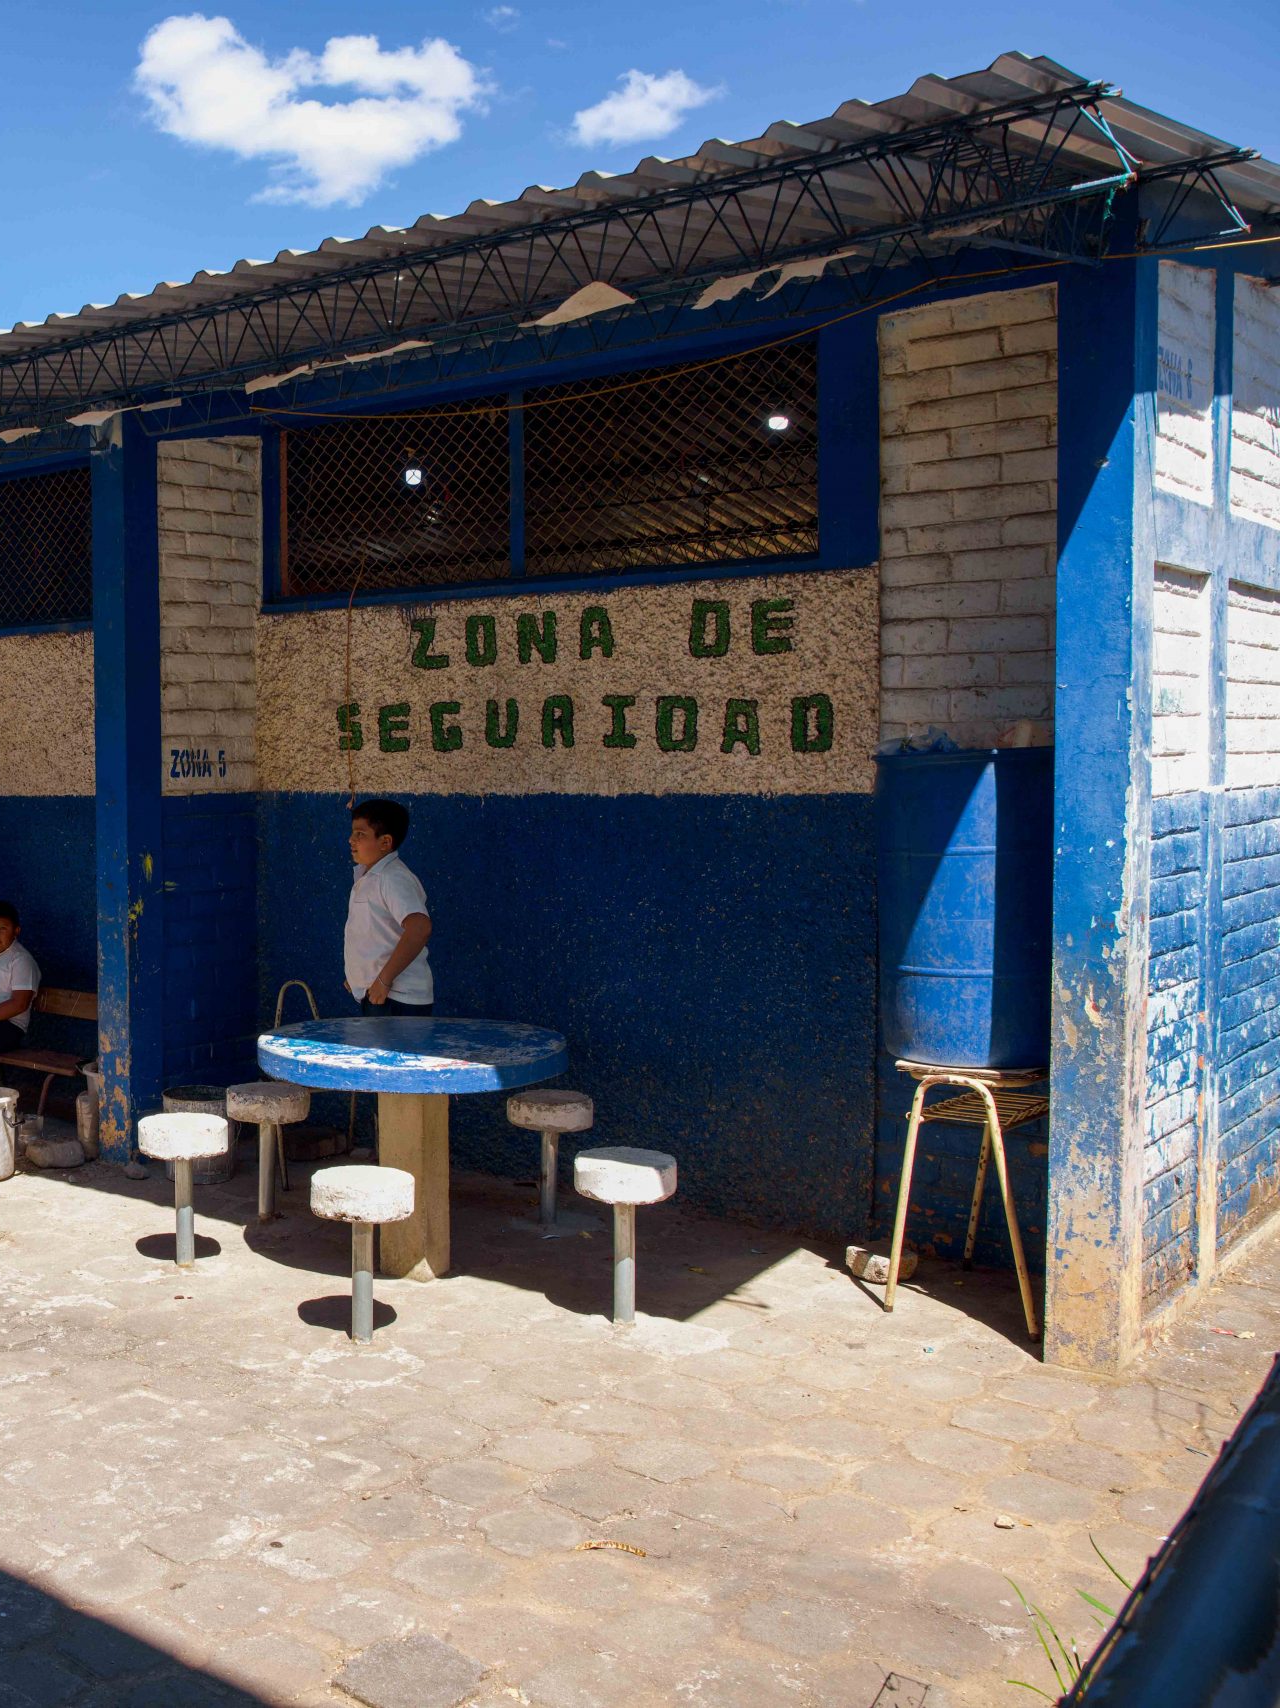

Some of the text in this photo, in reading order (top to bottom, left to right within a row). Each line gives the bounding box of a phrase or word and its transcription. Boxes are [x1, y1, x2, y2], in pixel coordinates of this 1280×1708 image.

[411, 598, 796, 669] ZONA DE
[335, 692, 835, 756] SEGURIDAD
[170, 748, 227, 778] ZONA 5
